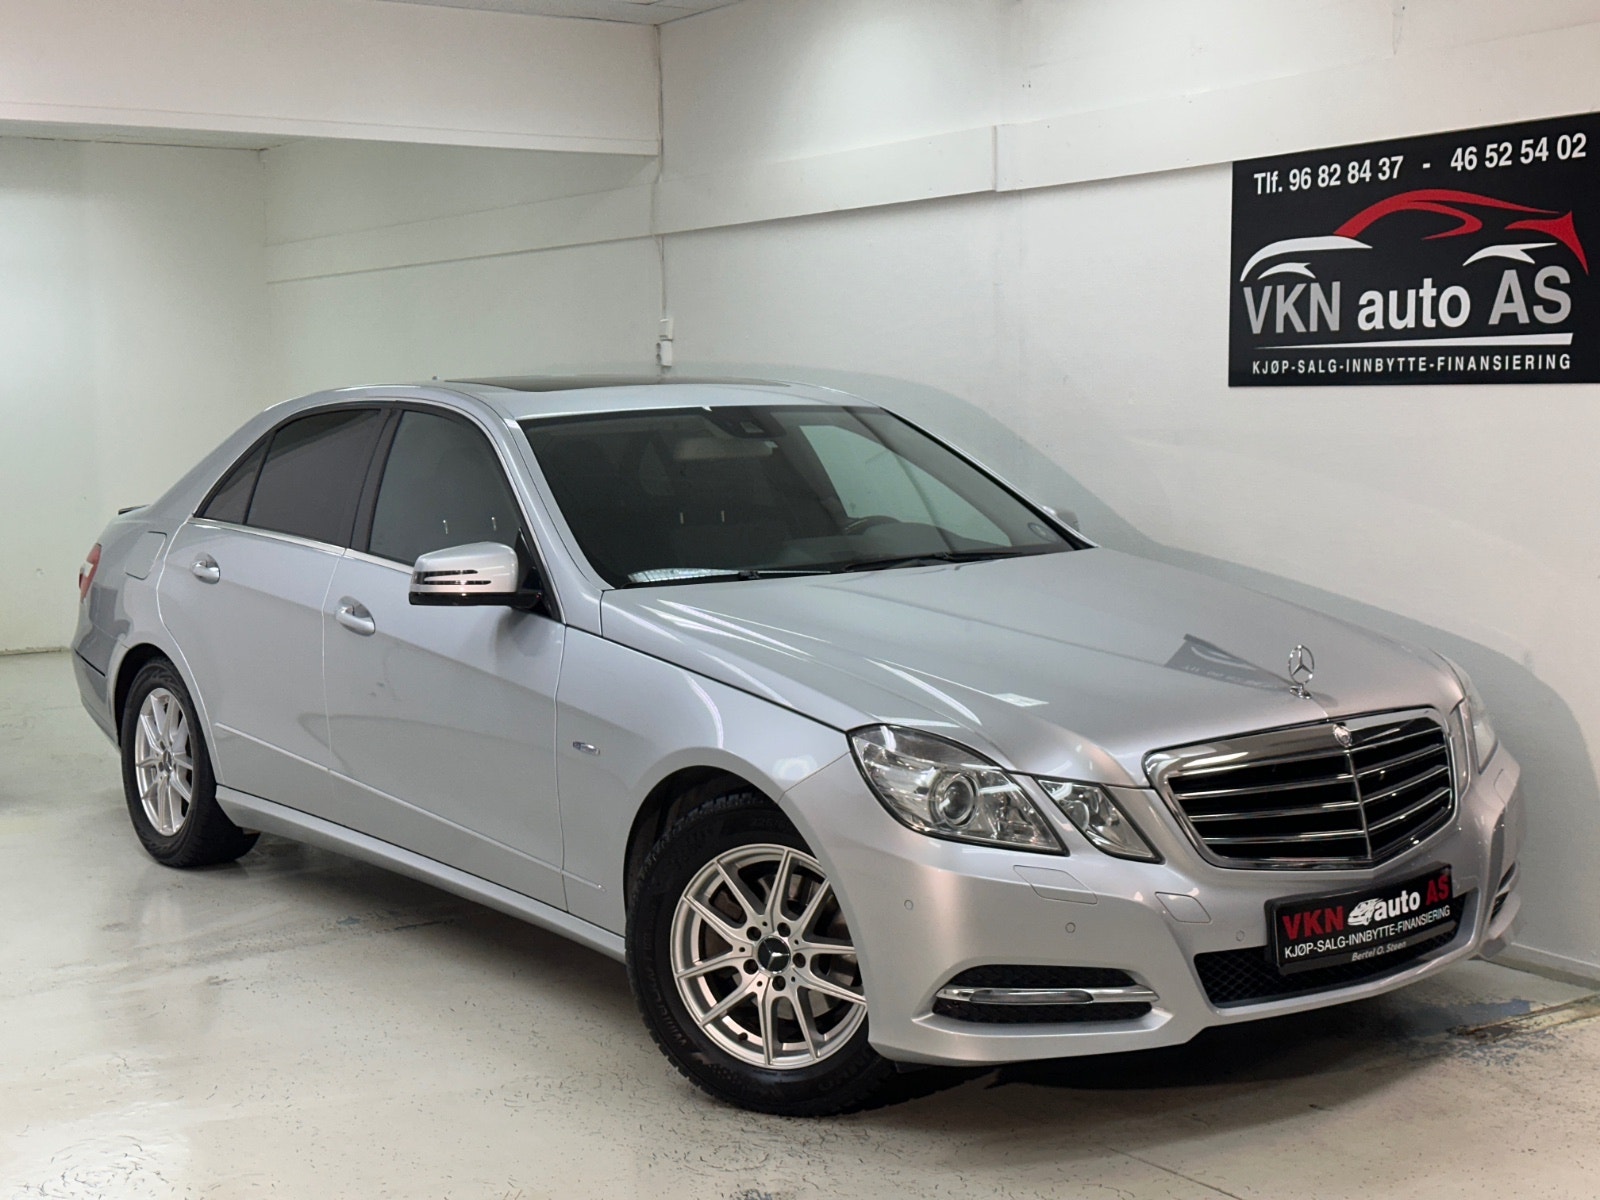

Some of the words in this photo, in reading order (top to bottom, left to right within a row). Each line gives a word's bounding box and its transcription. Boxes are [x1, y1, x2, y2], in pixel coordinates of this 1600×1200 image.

[1254, 171, 1283, 194] Tlf.
[1289, 168, 1311, 191] 96
[1318, 164, 1341, 187] 82
[1348, 160, 1371, 184] 84
[1378, 156, 1404, 180] 37
[1451, 146, 1477, 172] 46
[1485, 142, 1512, 168] 52
[1520, 137, 1549, 164] 54
[1556, 133, 1587, 159] 02
[1243, 281, 1340, 334] VKN
[1357, 278, 1470, 330] auto
[1488, 266, 1571, 325] AS
[1282, 906, 1344, 940] VKN
[1374, 890, 1420, 921] auto
[1426, 874, 1449, 905] AS
[1352, 948, 1376, 961] Bertel
[1386, 941, 1407, 953] Steen
